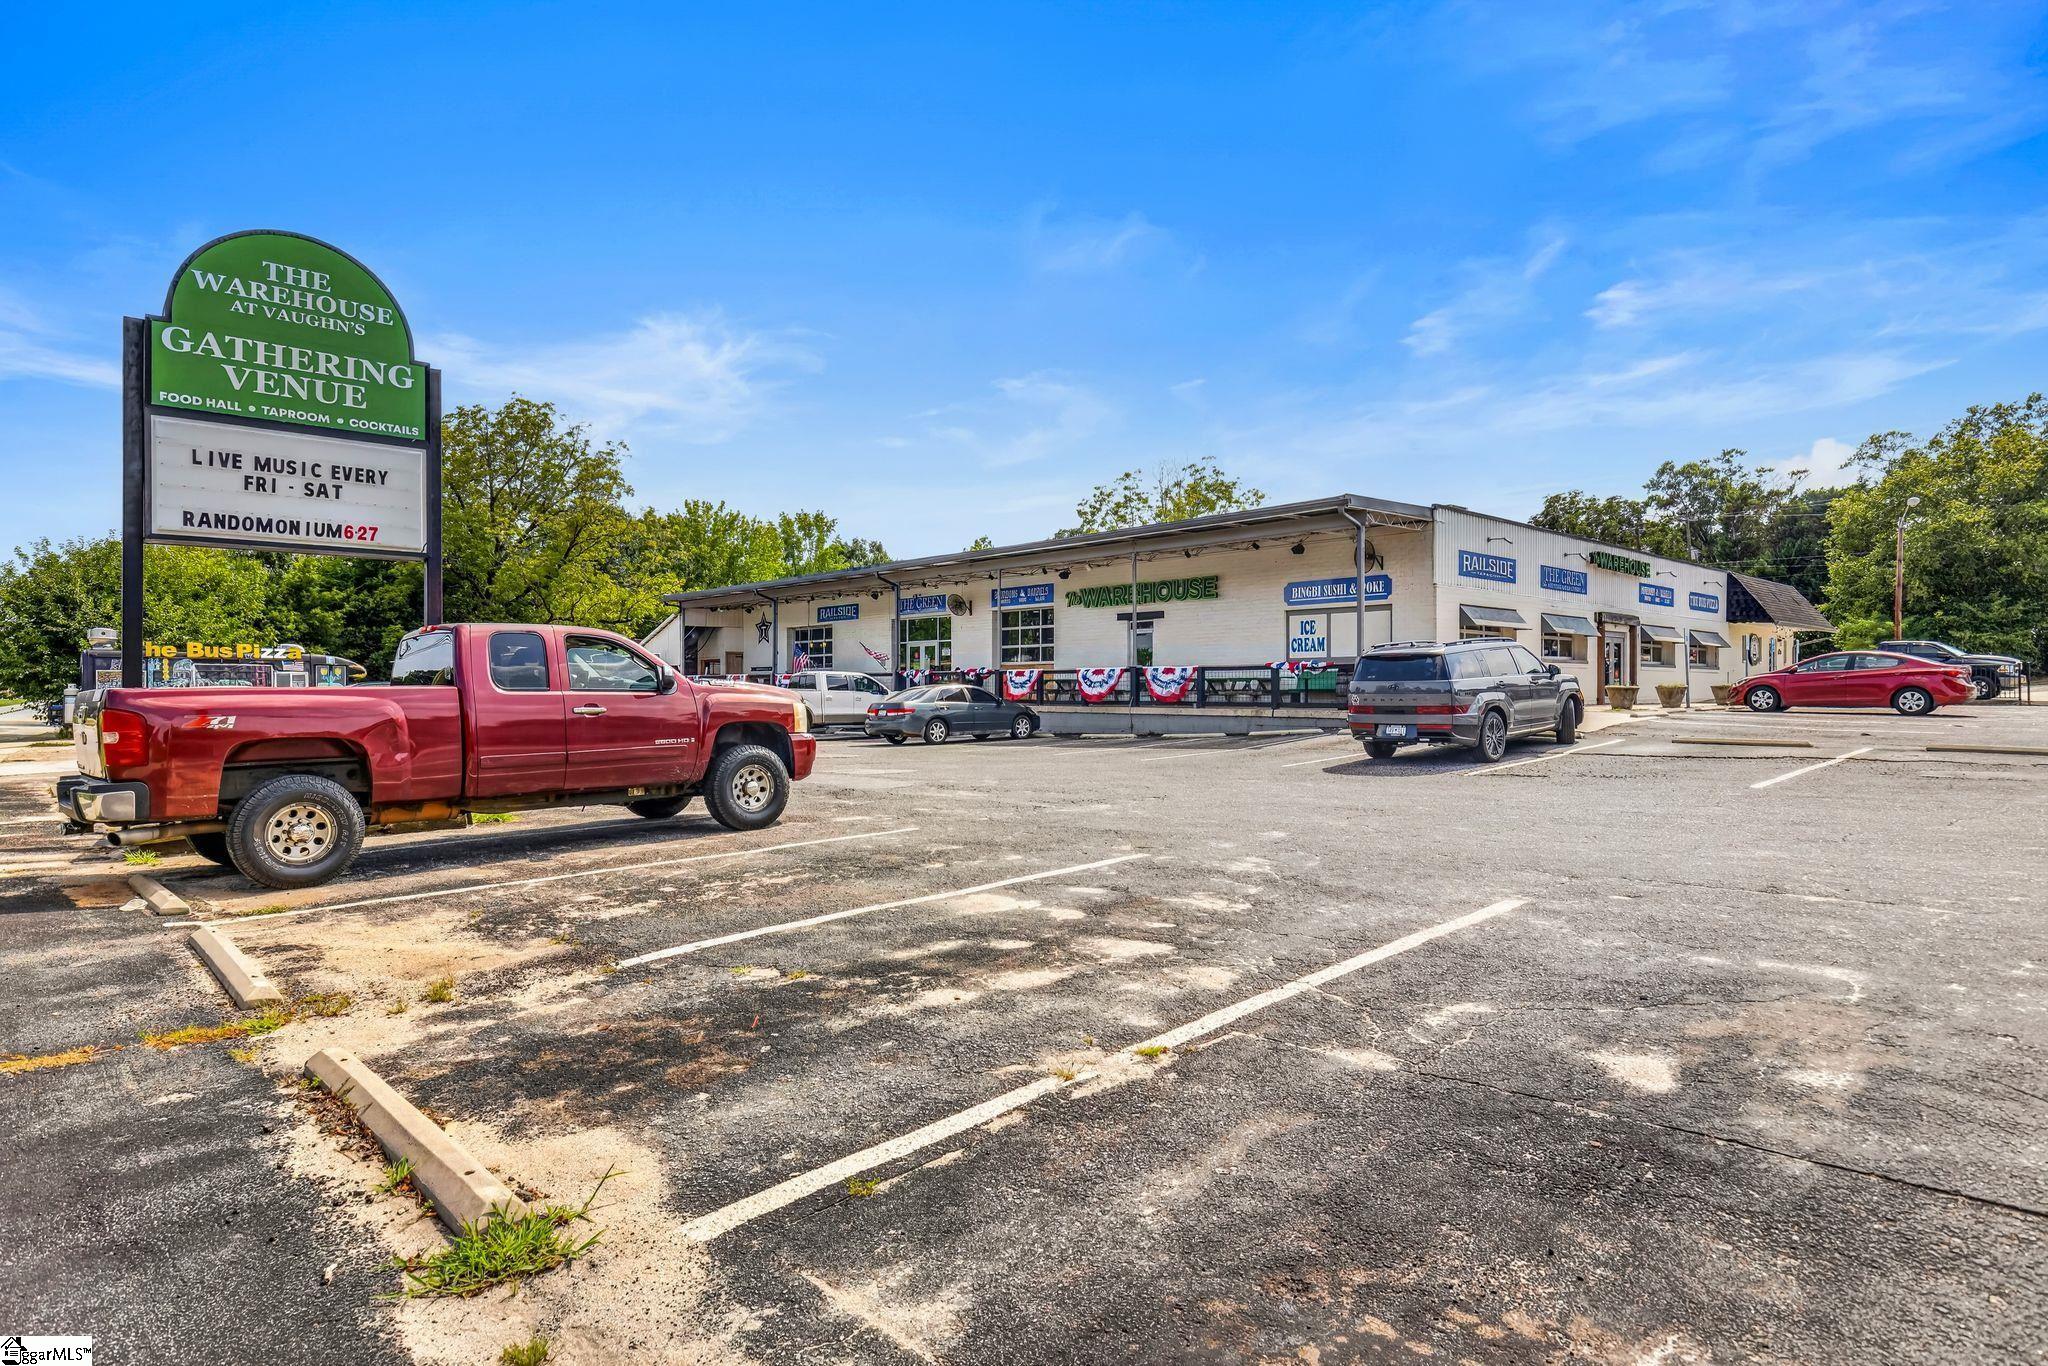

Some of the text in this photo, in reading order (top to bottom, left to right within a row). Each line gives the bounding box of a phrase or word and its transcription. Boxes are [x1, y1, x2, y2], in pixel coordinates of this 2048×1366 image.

[262, 260, 331, 293] THE
[191, 269, 394, 326] WAREHOUSE
[230, 300, 366, 336] AT VAUGHN'S
[161, 326, 415, 389] GATHERING
[220, 364, 367, 409] VENUE
[159, 391, 420, 436] FOOD HALL TAPROOM COCKTAILS
[192, 449, 389, 486] LIVE MUSIC EVERY
[243, 475, 277, 494] FRI
[303, 482, 343, 500] SAT
[1463, 554, 1514, 579] RAILSIDE
[1543, 567, 1585, 587] THE GREEN
[1599, 551, 1651, 578] WAREHOUSE
[900, 595, 943, 610] THE GREEN
[1065, 575, 1218, 608] The WAREHOUSE
[1292, 585, 1321, 599] BINGBI
[1323, 583, 1347, 596] SUSHI
[1349, 582, 1357, 594] &
[820, 605, 857, 619] RAILSIDE
[1300, 620, 1316, 635] ICE
[144, 640, 302, 660] he Bus Pizza
[1291, 637, 1325, 652] CREAM
